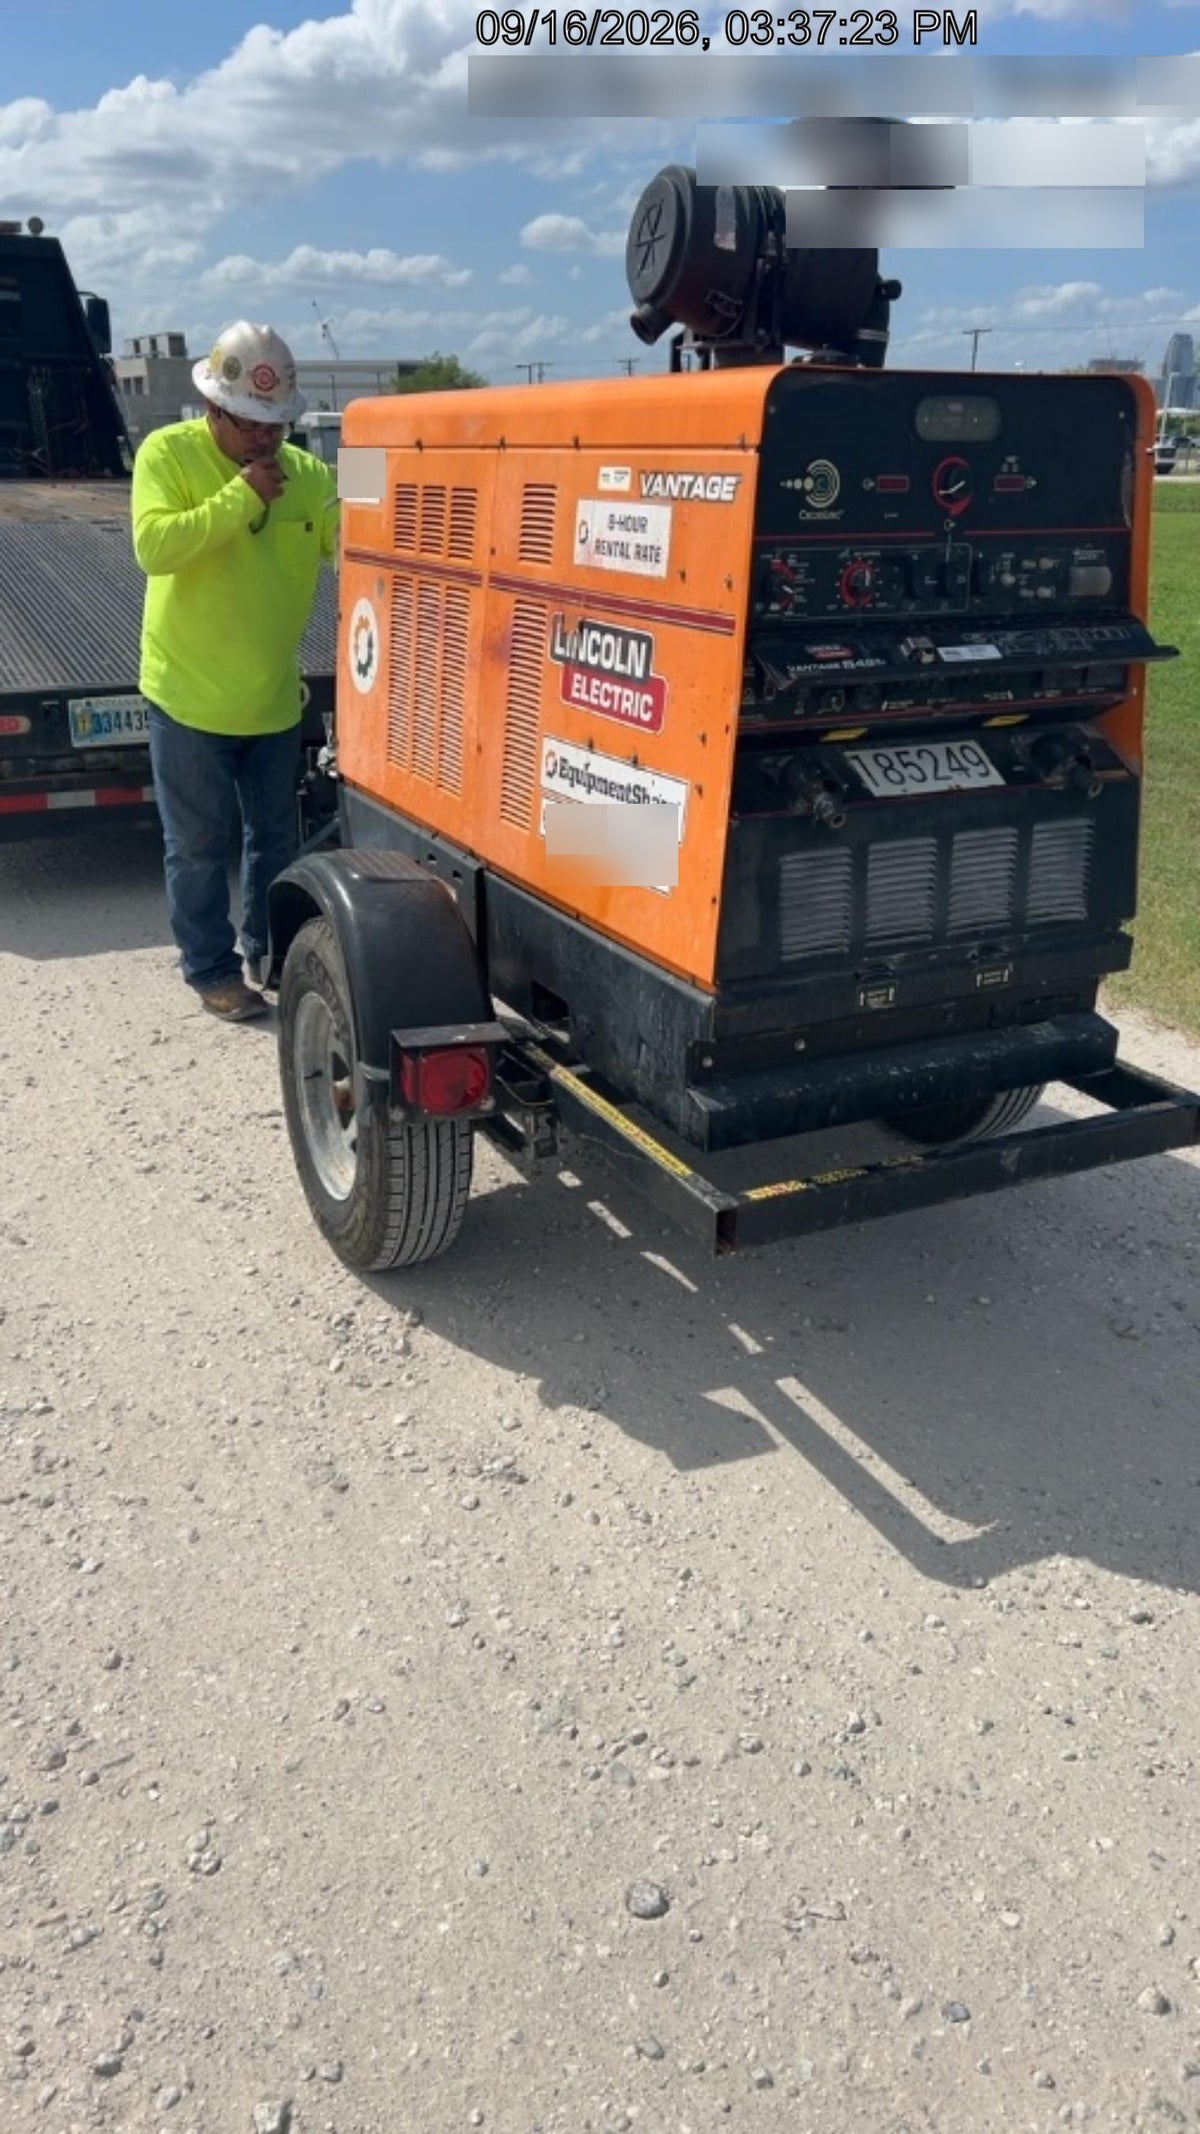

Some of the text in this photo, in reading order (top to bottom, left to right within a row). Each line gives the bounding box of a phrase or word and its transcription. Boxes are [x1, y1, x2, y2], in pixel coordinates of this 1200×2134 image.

[639, 472, 742, 502] VANTAGE
[594, 538, 662, 564] RENTAL RATE
[570, 673, 654, 722] ELECTRIC
[559, 756, 677, 805] EquipmentSh
[851, 743, 991, 788] 185249
